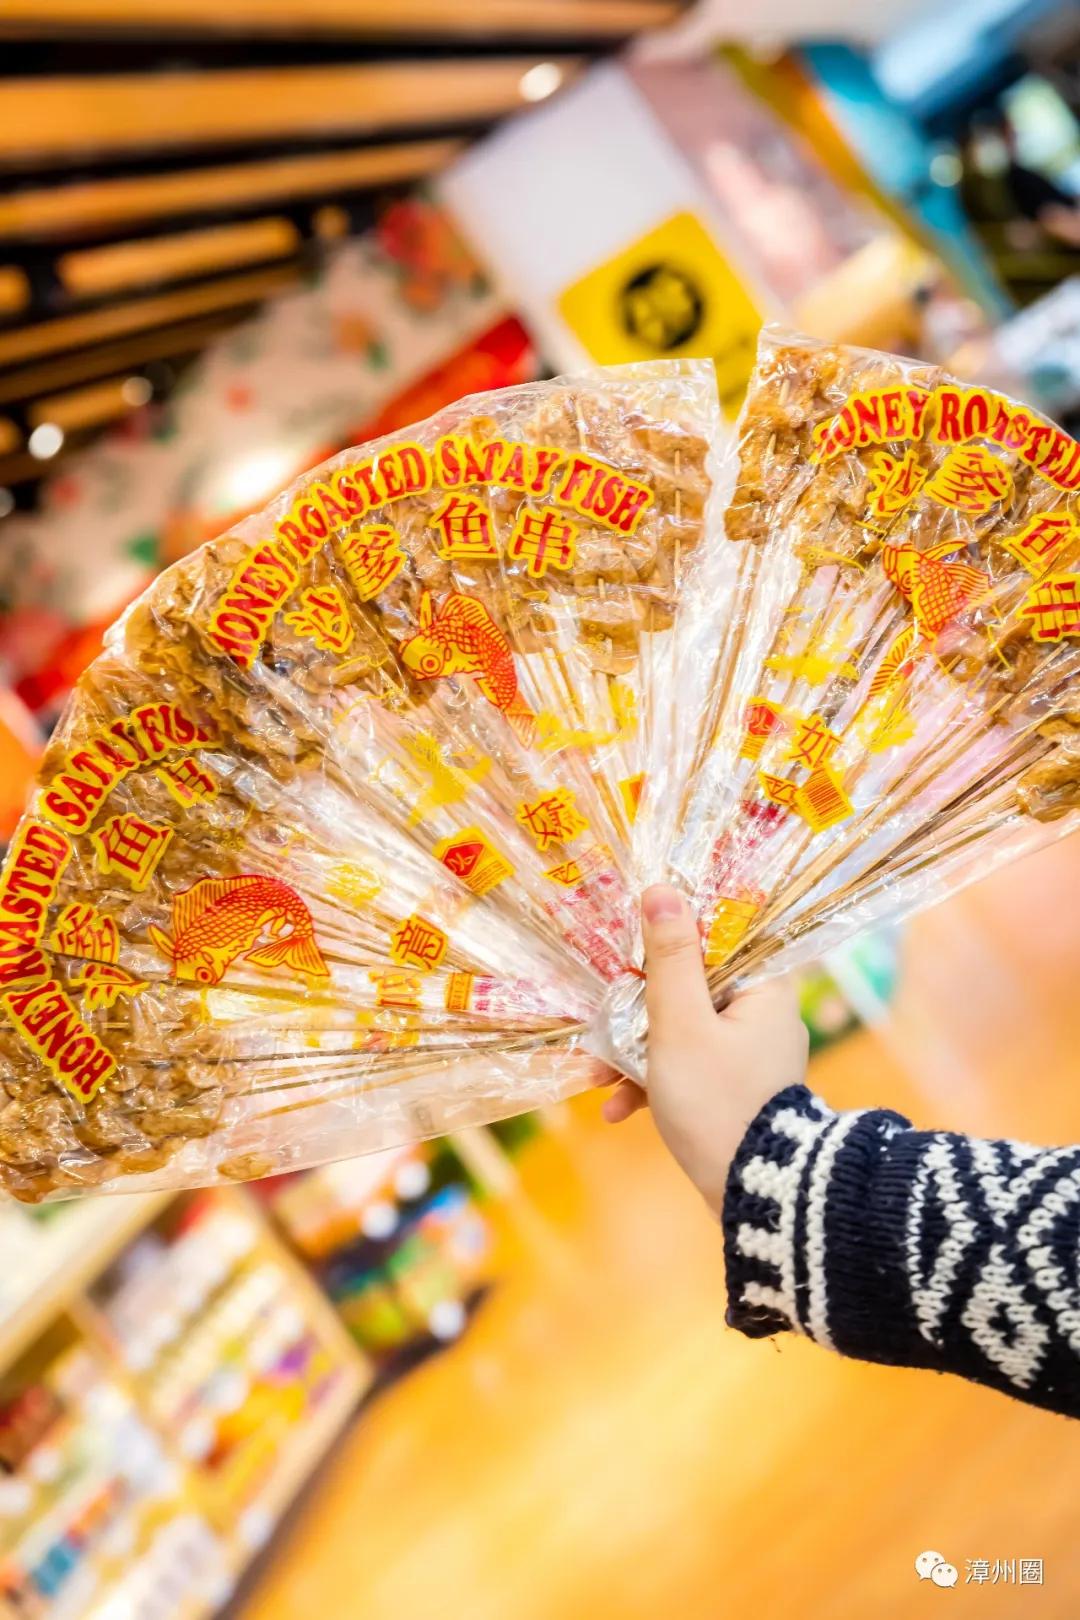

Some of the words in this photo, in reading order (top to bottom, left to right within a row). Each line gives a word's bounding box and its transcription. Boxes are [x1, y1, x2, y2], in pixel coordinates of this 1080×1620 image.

[277, 445, 428, 561] ROASTED
[439, 438, 561, 493] SATAY
[558, 457, 650, 533] FISH
[6, 980, 116, 1098] HONEY
